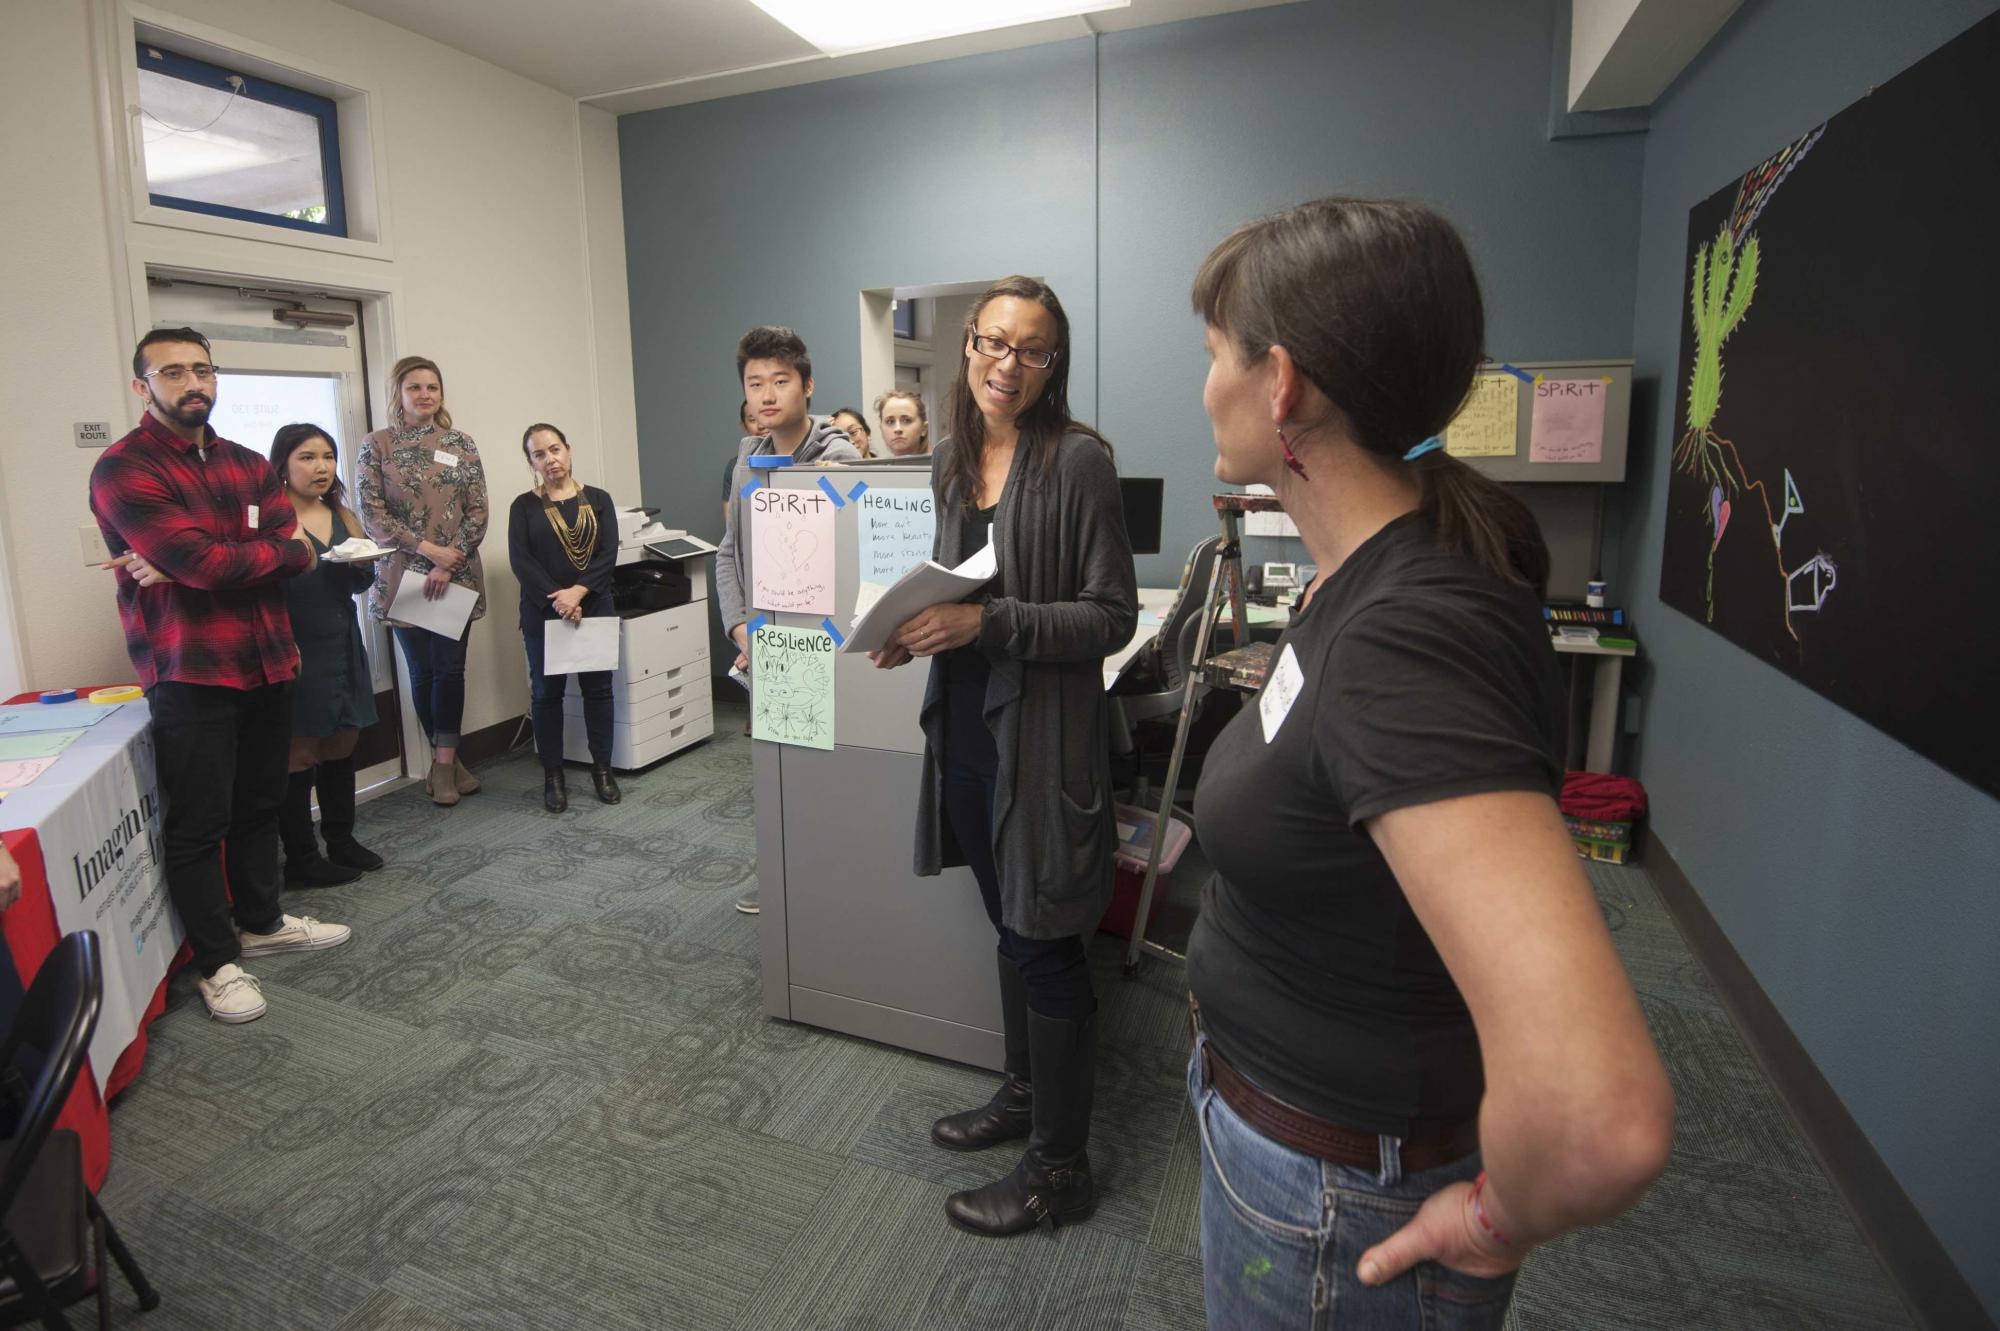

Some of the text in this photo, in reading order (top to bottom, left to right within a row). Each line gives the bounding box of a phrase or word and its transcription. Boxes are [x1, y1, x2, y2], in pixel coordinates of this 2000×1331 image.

[1472, 377, 1506, 390] art
[84, 424, 101, 432] EXIT
[80, 432, 107, 440] ROUTE
